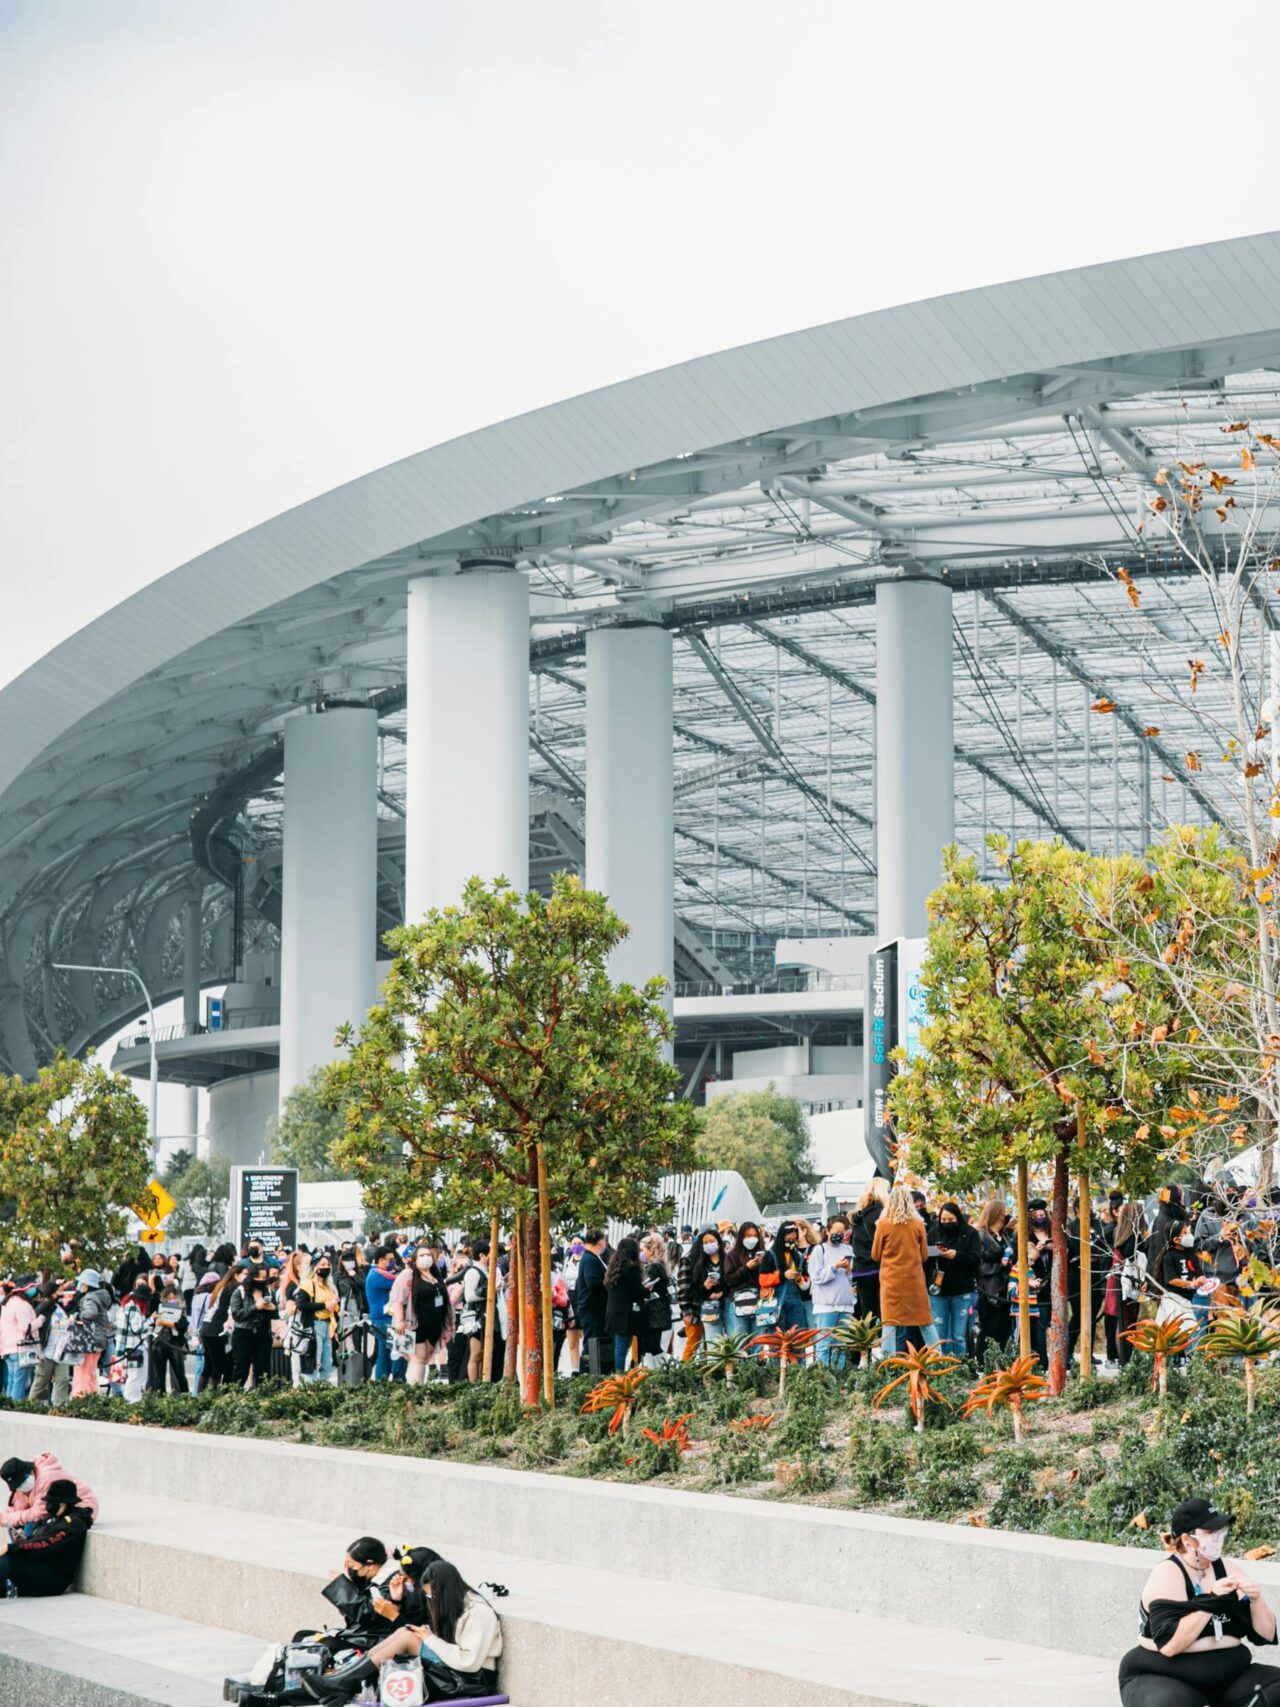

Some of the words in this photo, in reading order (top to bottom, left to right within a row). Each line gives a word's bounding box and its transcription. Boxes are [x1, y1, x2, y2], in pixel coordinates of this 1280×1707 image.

[873, 959, 884, 1017] Stadium
[873, 1033, 884, 1065] SoFi
[875, 1097, 883, 1127] ENTRY
